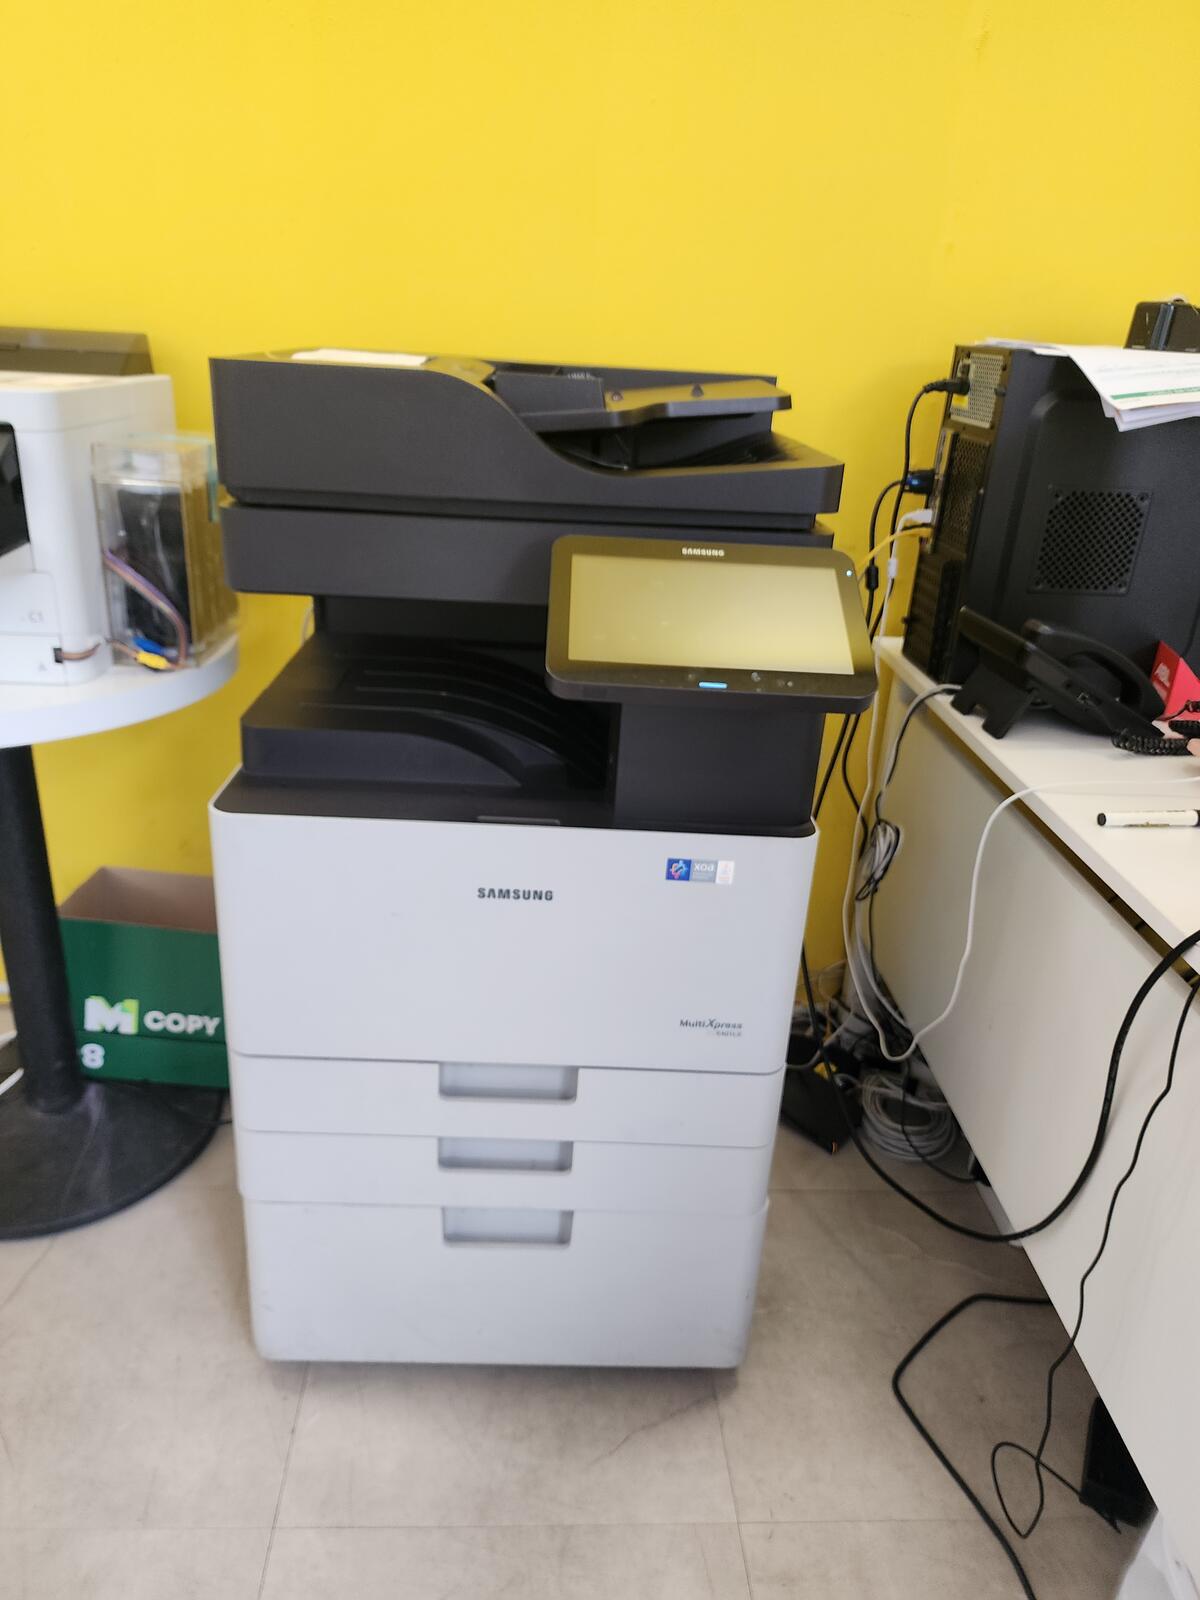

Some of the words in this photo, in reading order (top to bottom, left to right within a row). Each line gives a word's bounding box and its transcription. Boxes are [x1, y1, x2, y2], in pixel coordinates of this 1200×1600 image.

[681, 547, 724, 557] SAMSUNG
[477, 887, 553, 901] SAMSUNG
[144, 1010, 220, 1036] COPY
[679, 1018, 743, 1030] MultiXpress
